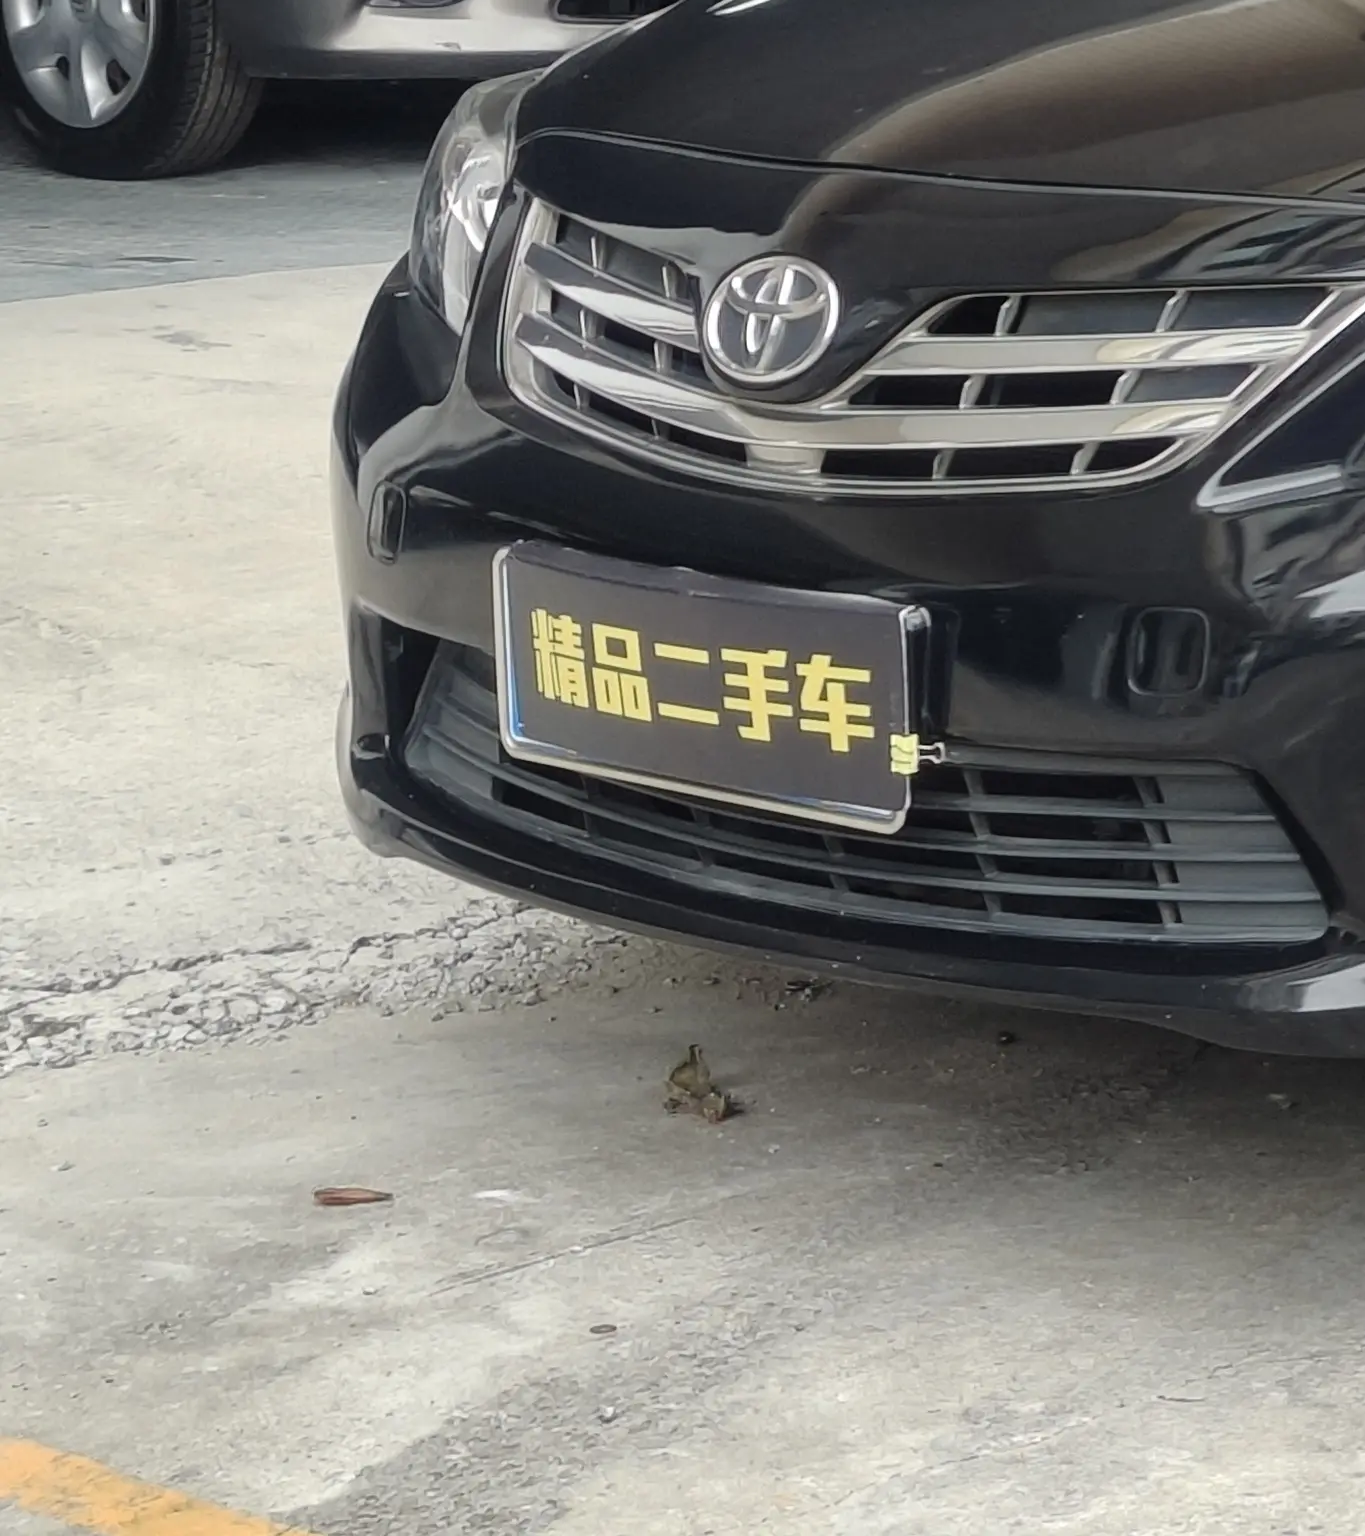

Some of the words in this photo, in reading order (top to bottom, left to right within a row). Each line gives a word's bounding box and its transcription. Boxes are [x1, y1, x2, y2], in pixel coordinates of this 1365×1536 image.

[531, 608, 875, 752] 精品二手车
